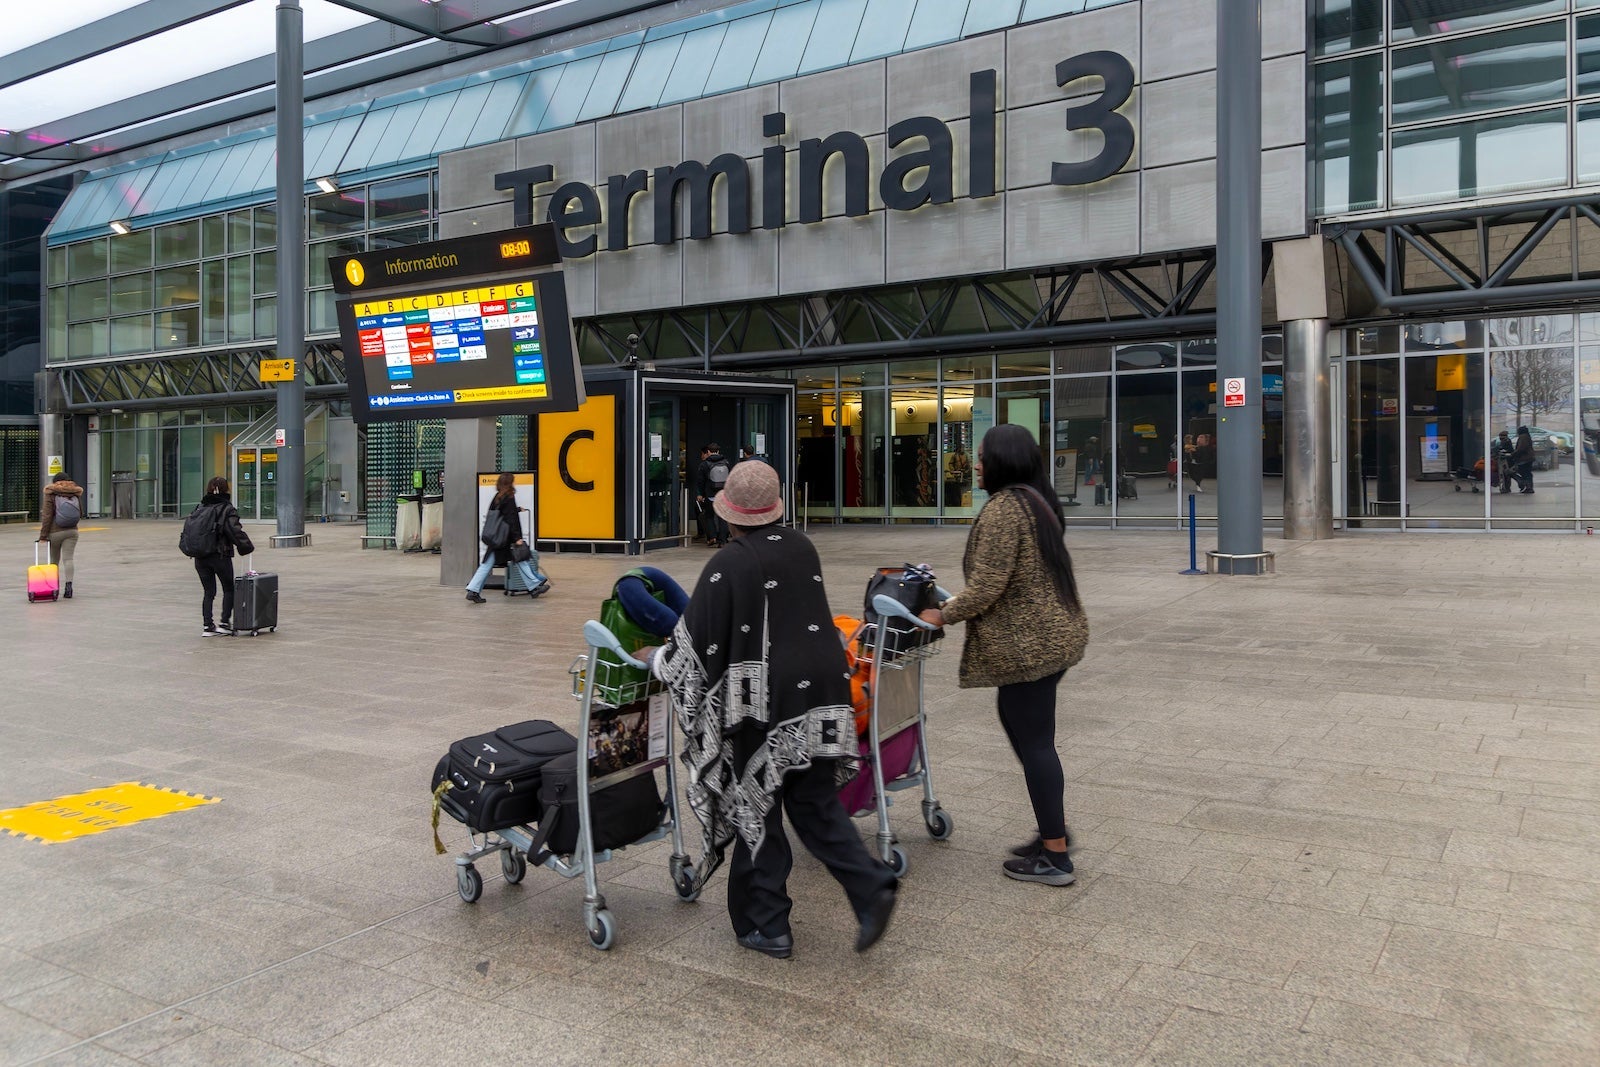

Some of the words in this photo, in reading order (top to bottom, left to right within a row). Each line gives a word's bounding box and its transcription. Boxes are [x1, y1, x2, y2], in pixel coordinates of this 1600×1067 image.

[494, 68, 997, 258] Terminal
[1051, 49, 1137, 187] 3
[501, 240, 531, 258] 08:00
[385, 253, 459, 276] Information
[365, 304, 372, 316] A
[387, 301, 395, 313] B
[411, 298, 419, 310] C
[436, 295, 445, 307] D
[462, 291, 469, 304] E
[489, 287, 496, 300] F
[515, 283, 525, 297] G
[462, 391, 475, 399] Check
[558, 429, 595, 492] C
